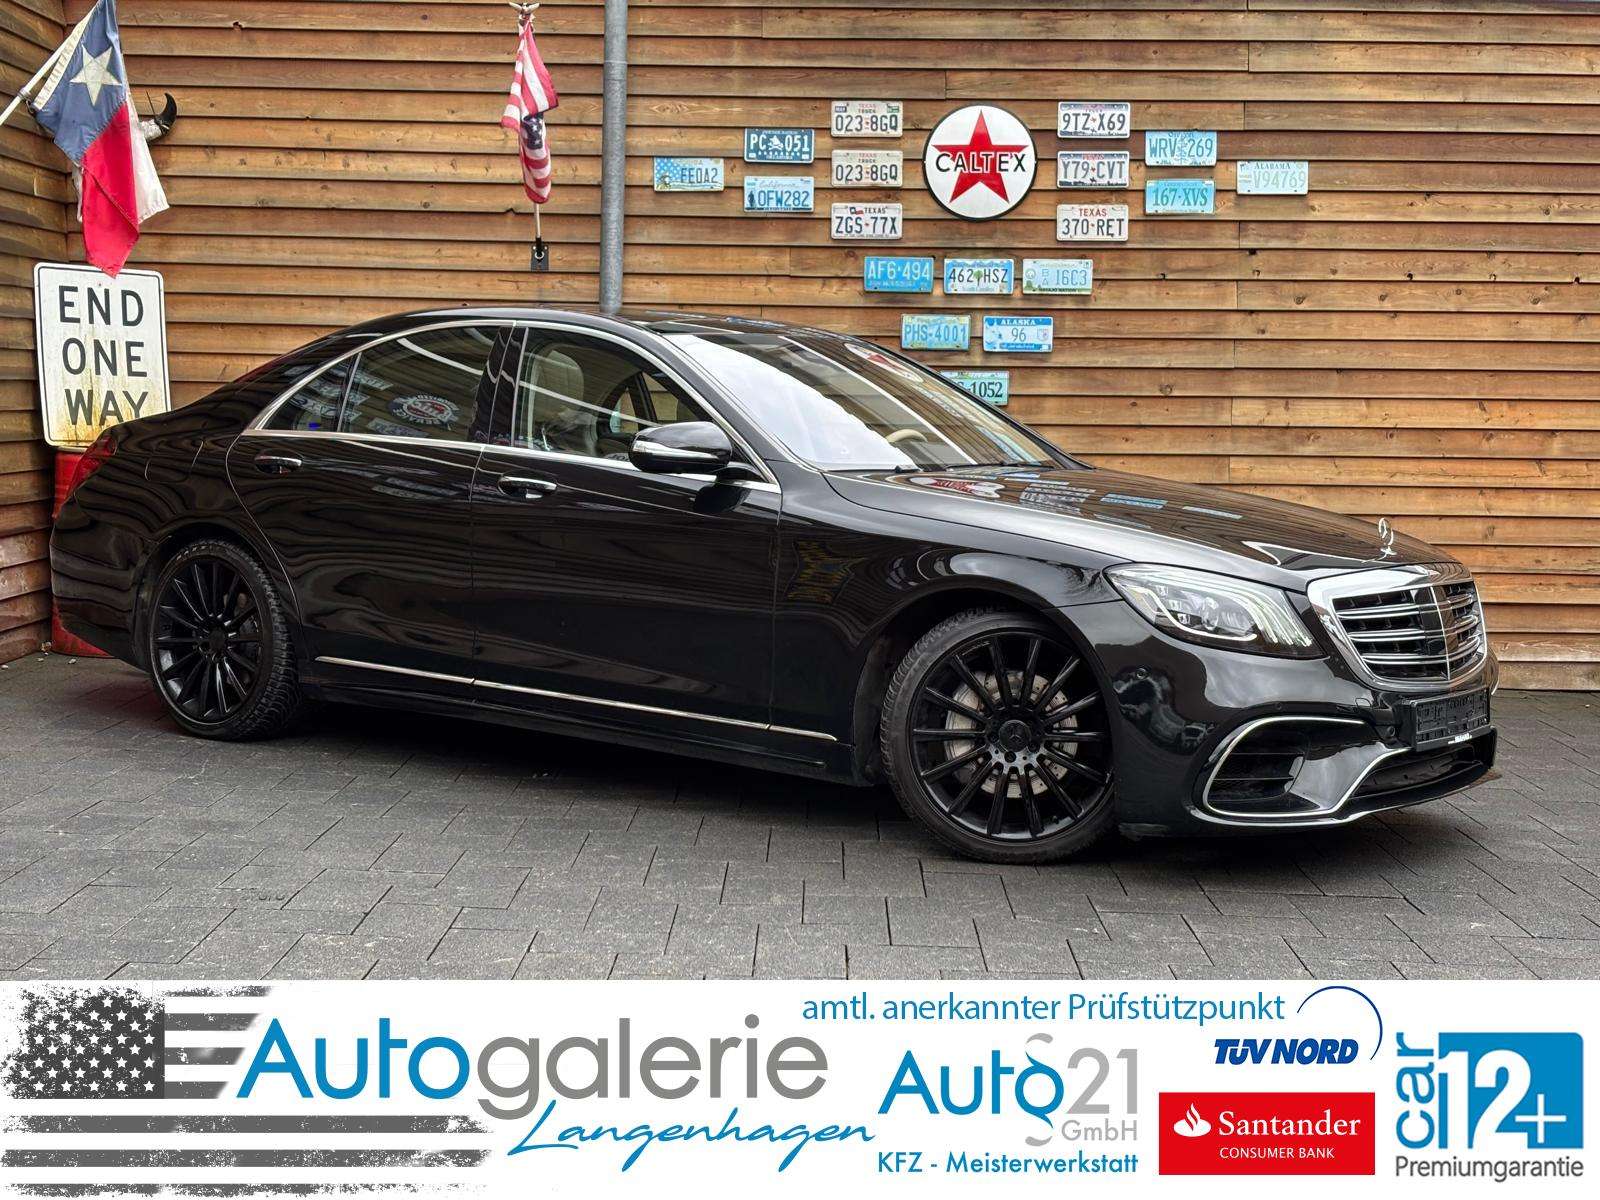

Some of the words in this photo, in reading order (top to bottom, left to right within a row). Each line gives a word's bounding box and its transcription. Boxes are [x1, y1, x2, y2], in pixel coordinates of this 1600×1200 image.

[750, 133, 767, 150] PC
[784, 134, 810, 152] 051
[1149, 138, 1178, 158] WRV
[1187, 138, 1213, 158] 269
[935, 152, 1026, 172] CALTEX
[1061, 161, 1090, 179] Y79
[1096, 161, 1125, 179] CVT
[1079, 208, 1107, 217] TEXAS
[835, 216, 863, 234] ZGS
[870, 216, 898, 234] 77X
[1062, 218, 1090, 236] 370
[1096, 218, 1124, 236] RET
[949, 268, 974, 283] 462
[983, 268, 1009, 283] HSZ
[58, 285, 144, 327] END
[1011, 327, 1027, 342] 96
[62, 337, 148, 377] ONE
[64, 388, 149, 426] WAY
